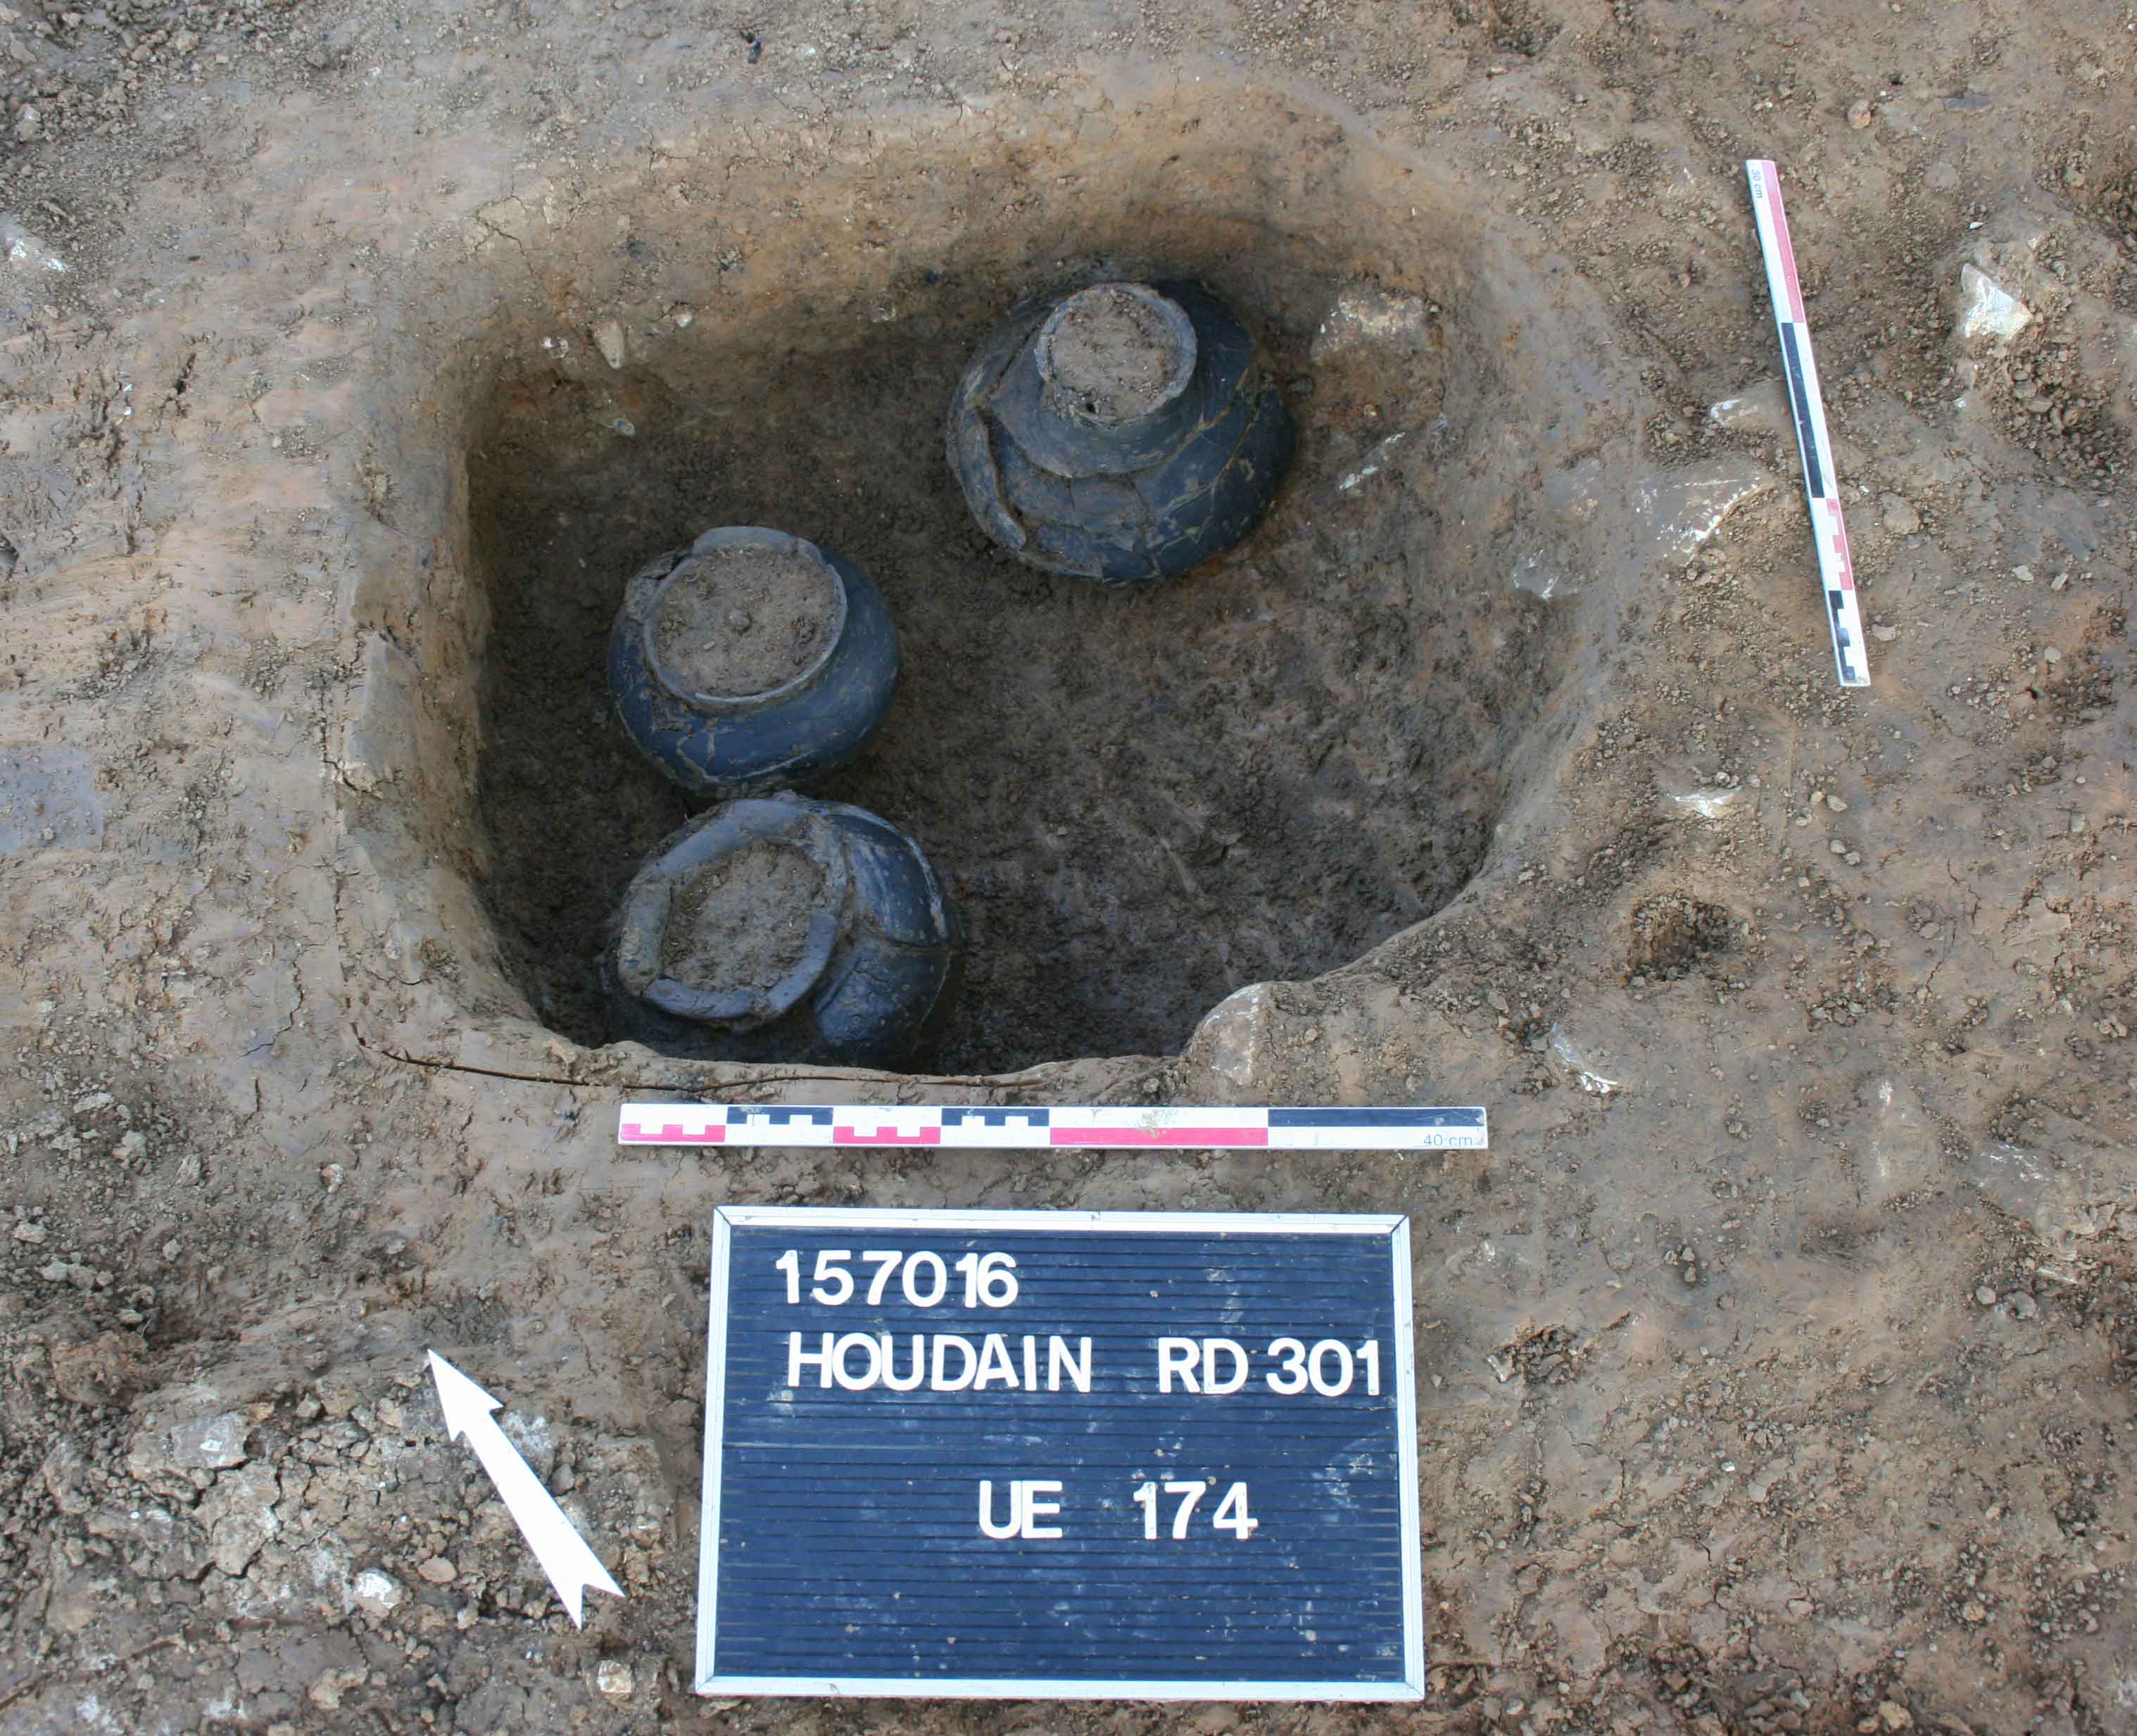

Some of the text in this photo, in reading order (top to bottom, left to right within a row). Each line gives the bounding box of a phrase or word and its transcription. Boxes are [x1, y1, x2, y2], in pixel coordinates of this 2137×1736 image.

[1754, 184, 1763, 198] cm
[1423, 1133, 1473, 1147] 40 cm
[776, 1250, 1019, 1308] 157016
[787, 1331, 1380, 1397] HOUDAIN RD 301
[979, 1480, 1259, 1540] UE 174
